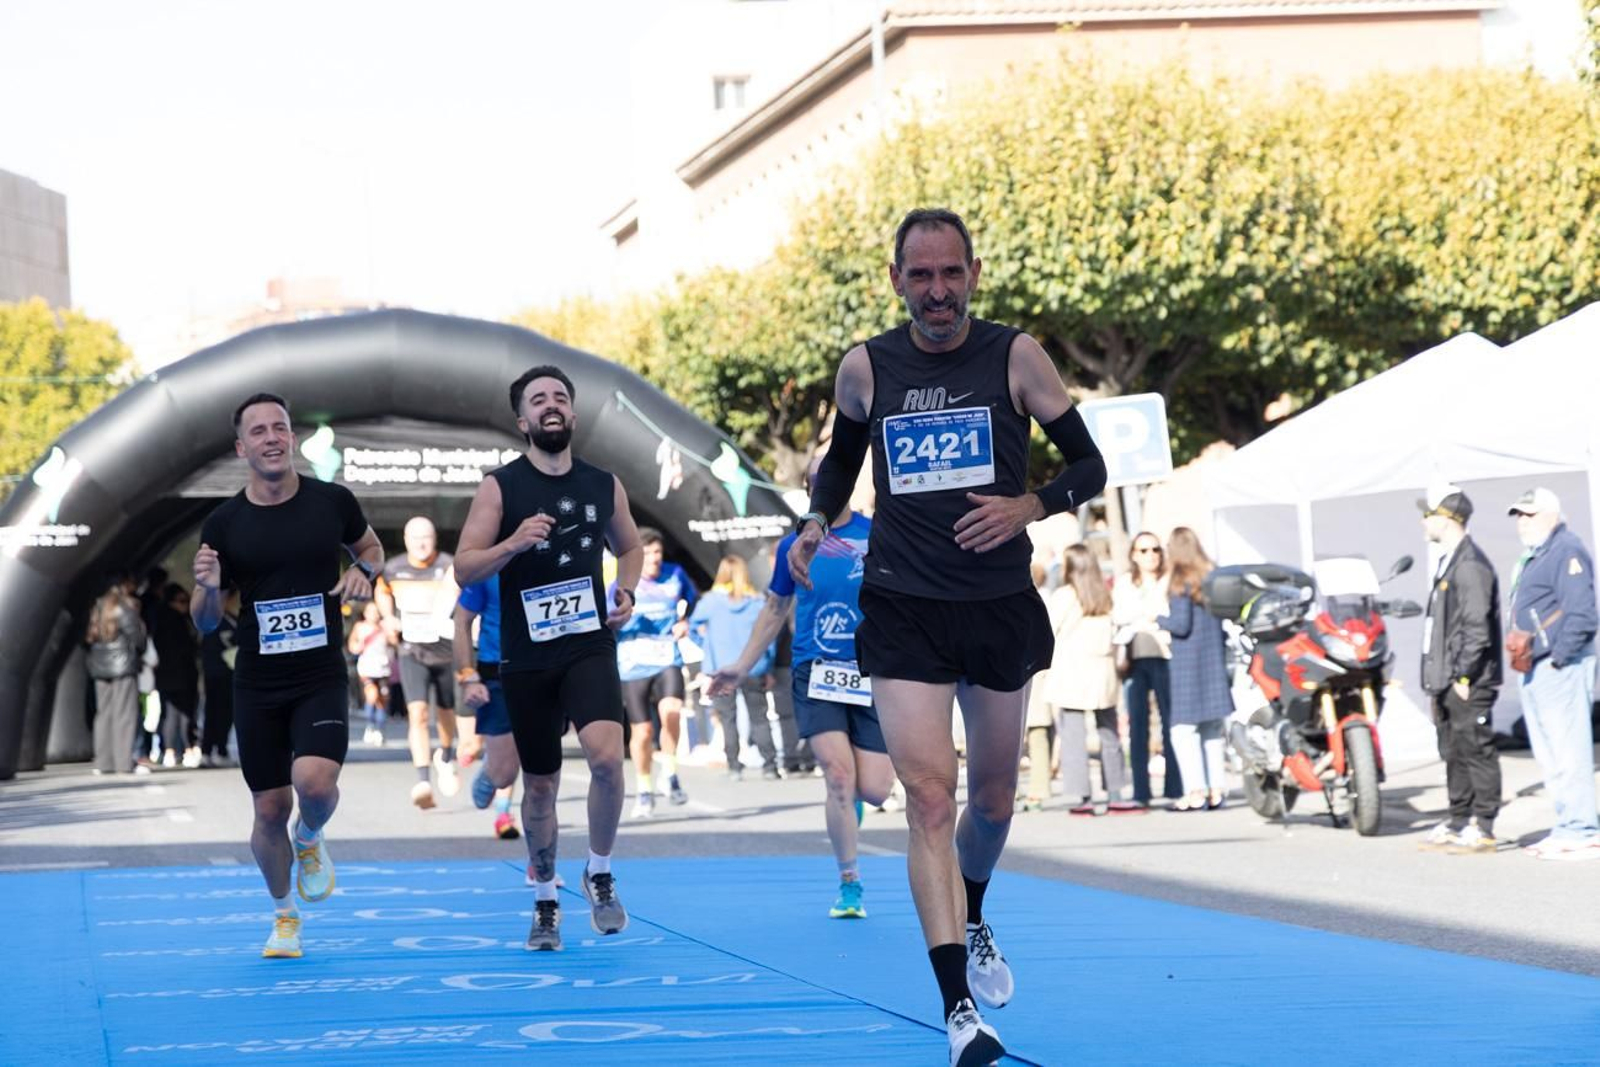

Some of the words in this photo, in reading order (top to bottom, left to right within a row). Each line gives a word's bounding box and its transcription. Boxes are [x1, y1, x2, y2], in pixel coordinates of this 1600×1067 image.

[903, 387, 946, 411] RUN
[894, 429, 980, 464] 2421
[1096, 407, 1149, 479] P
[344, 465, 417, 485] Deportes
[418, 466, 441, 483] de
[538, 595, 582, 619] 727
[268, 611, 312, 633] 238
[823, 670, 861, 689] 838
